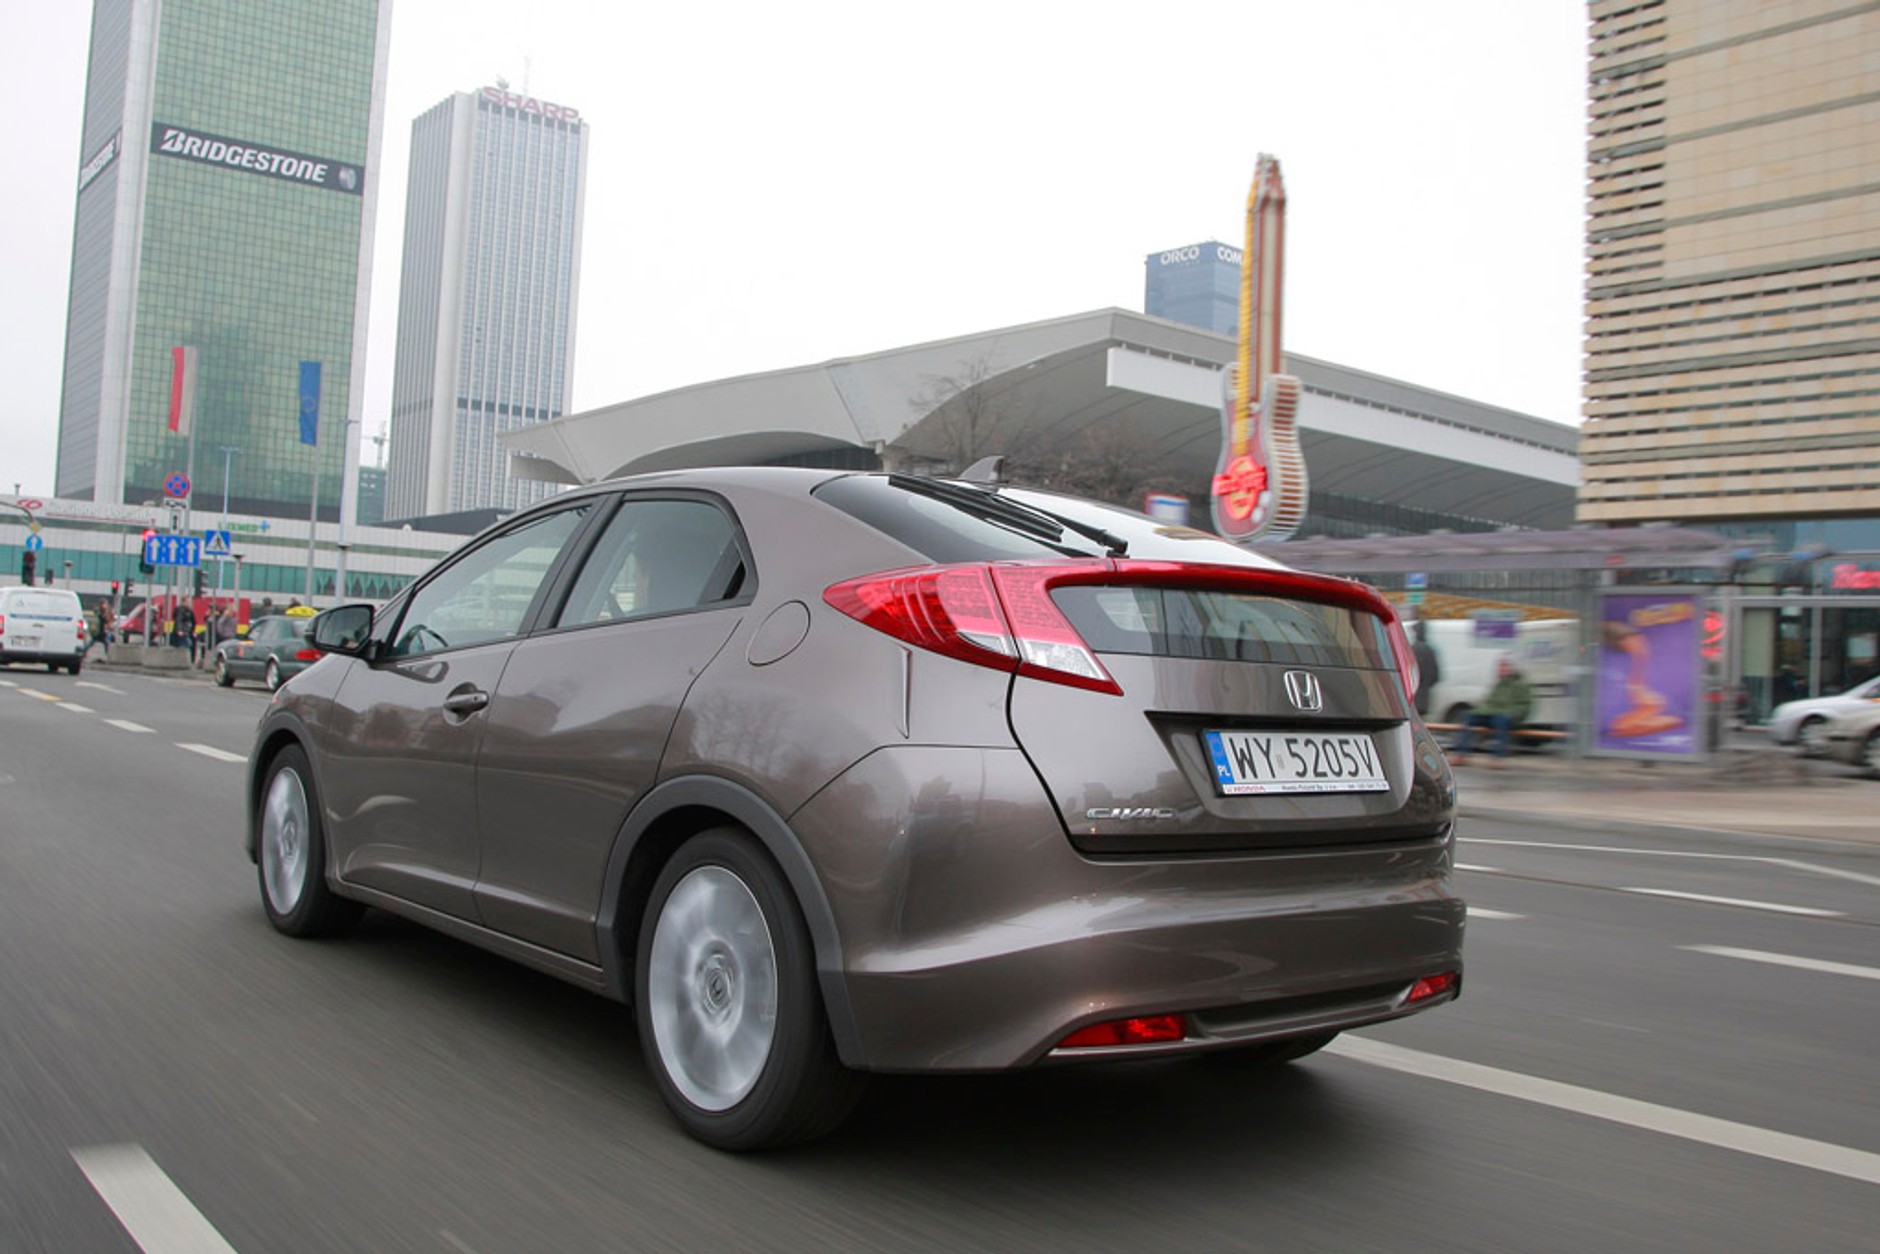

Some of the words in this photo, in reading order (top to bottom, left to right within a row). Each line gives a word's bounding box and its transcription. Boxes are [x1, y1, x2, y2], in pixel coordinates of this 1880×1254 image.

[482, 86, 580, 120] SHARP
[160, 128, 329, 183] BRIDGESTONE
[1160, 246, 1200, 265] ORCO
[1217, 765, 1231, 777] PL
[1228, 737, 1276, 779] WY
[1285, 738, 1374, 778] 5205V
[1086, 806, 1176, 821] CIVIC
